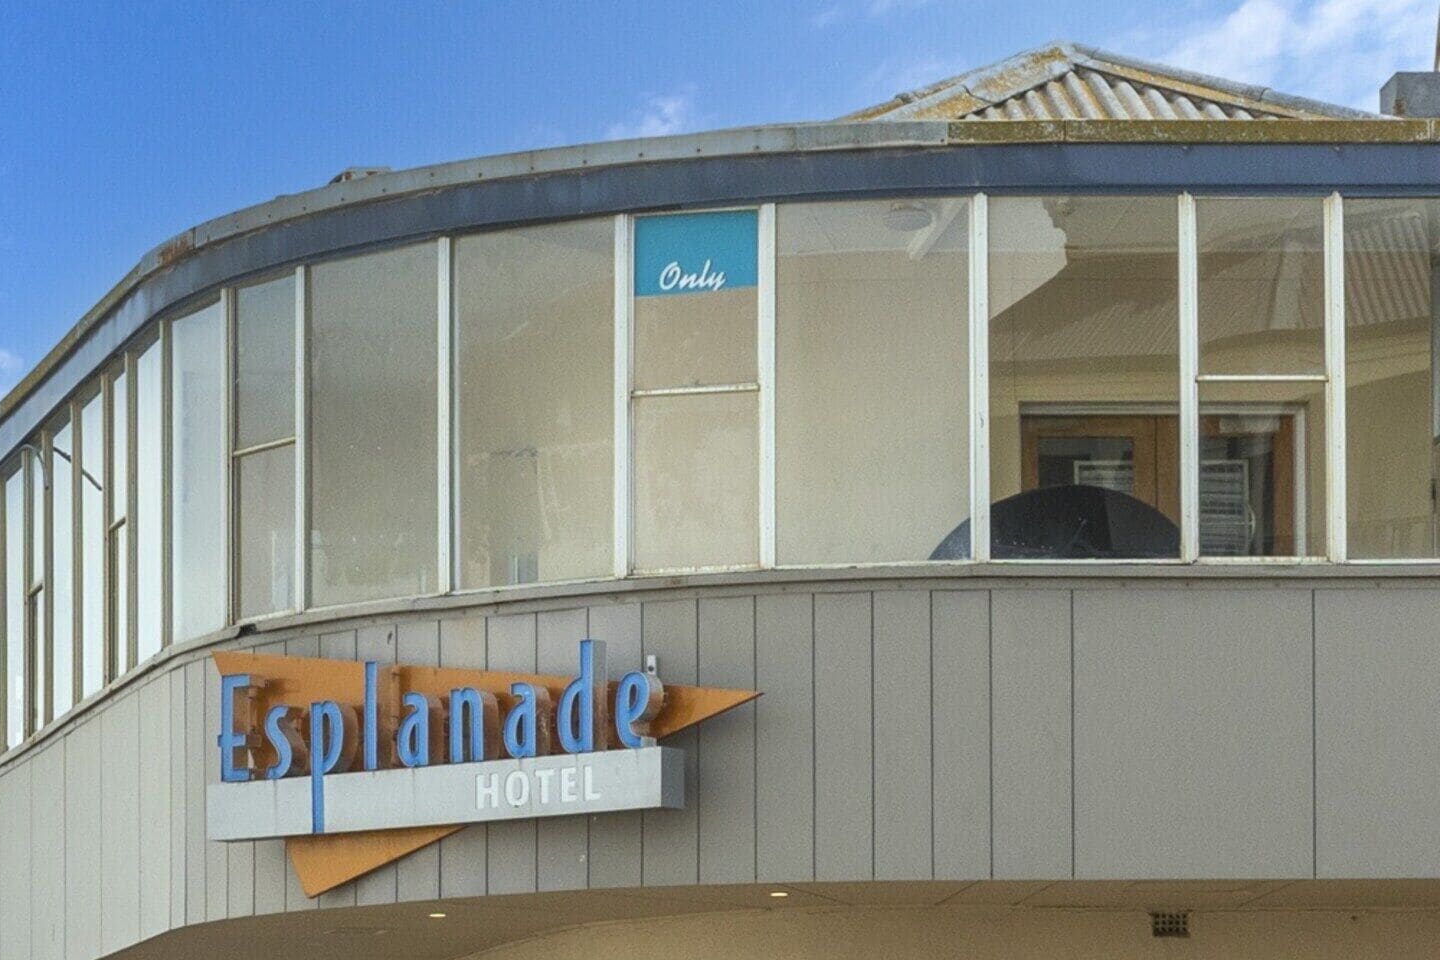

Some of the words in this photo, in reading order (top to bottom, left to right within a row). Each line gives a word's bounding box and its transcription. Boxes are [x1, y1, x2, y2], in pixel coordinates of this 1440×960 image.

[659, 260, 726, 291] Only
[218, 638, 658, 835] Esplanade
[474, 764, 601, 810] HOTEL
